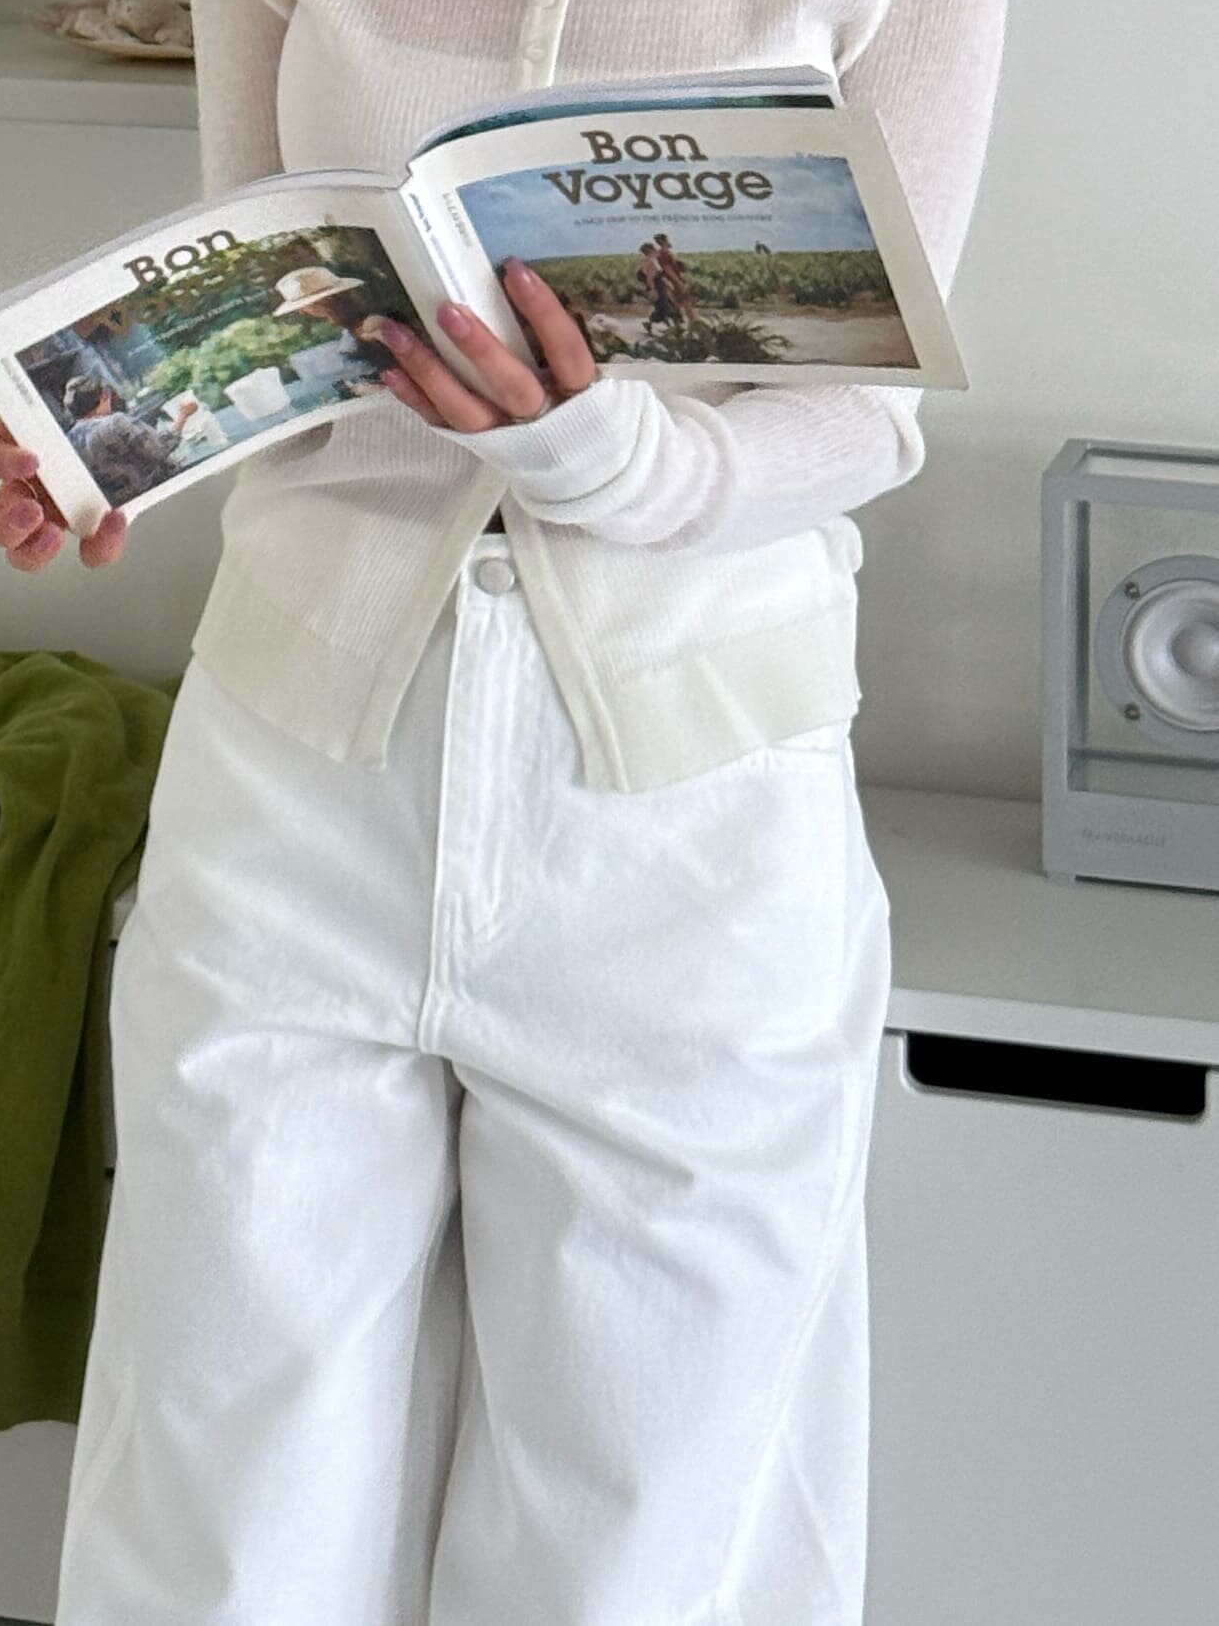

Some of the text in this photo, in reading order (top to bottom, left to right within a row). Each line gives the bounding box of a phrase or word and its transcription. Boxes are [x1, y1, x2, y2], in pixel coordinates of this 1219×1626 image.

[580, 130, 709, 165] Bon
[541, 169, 774, 211] Voyage
[122, 230, 244, 291] Bon
